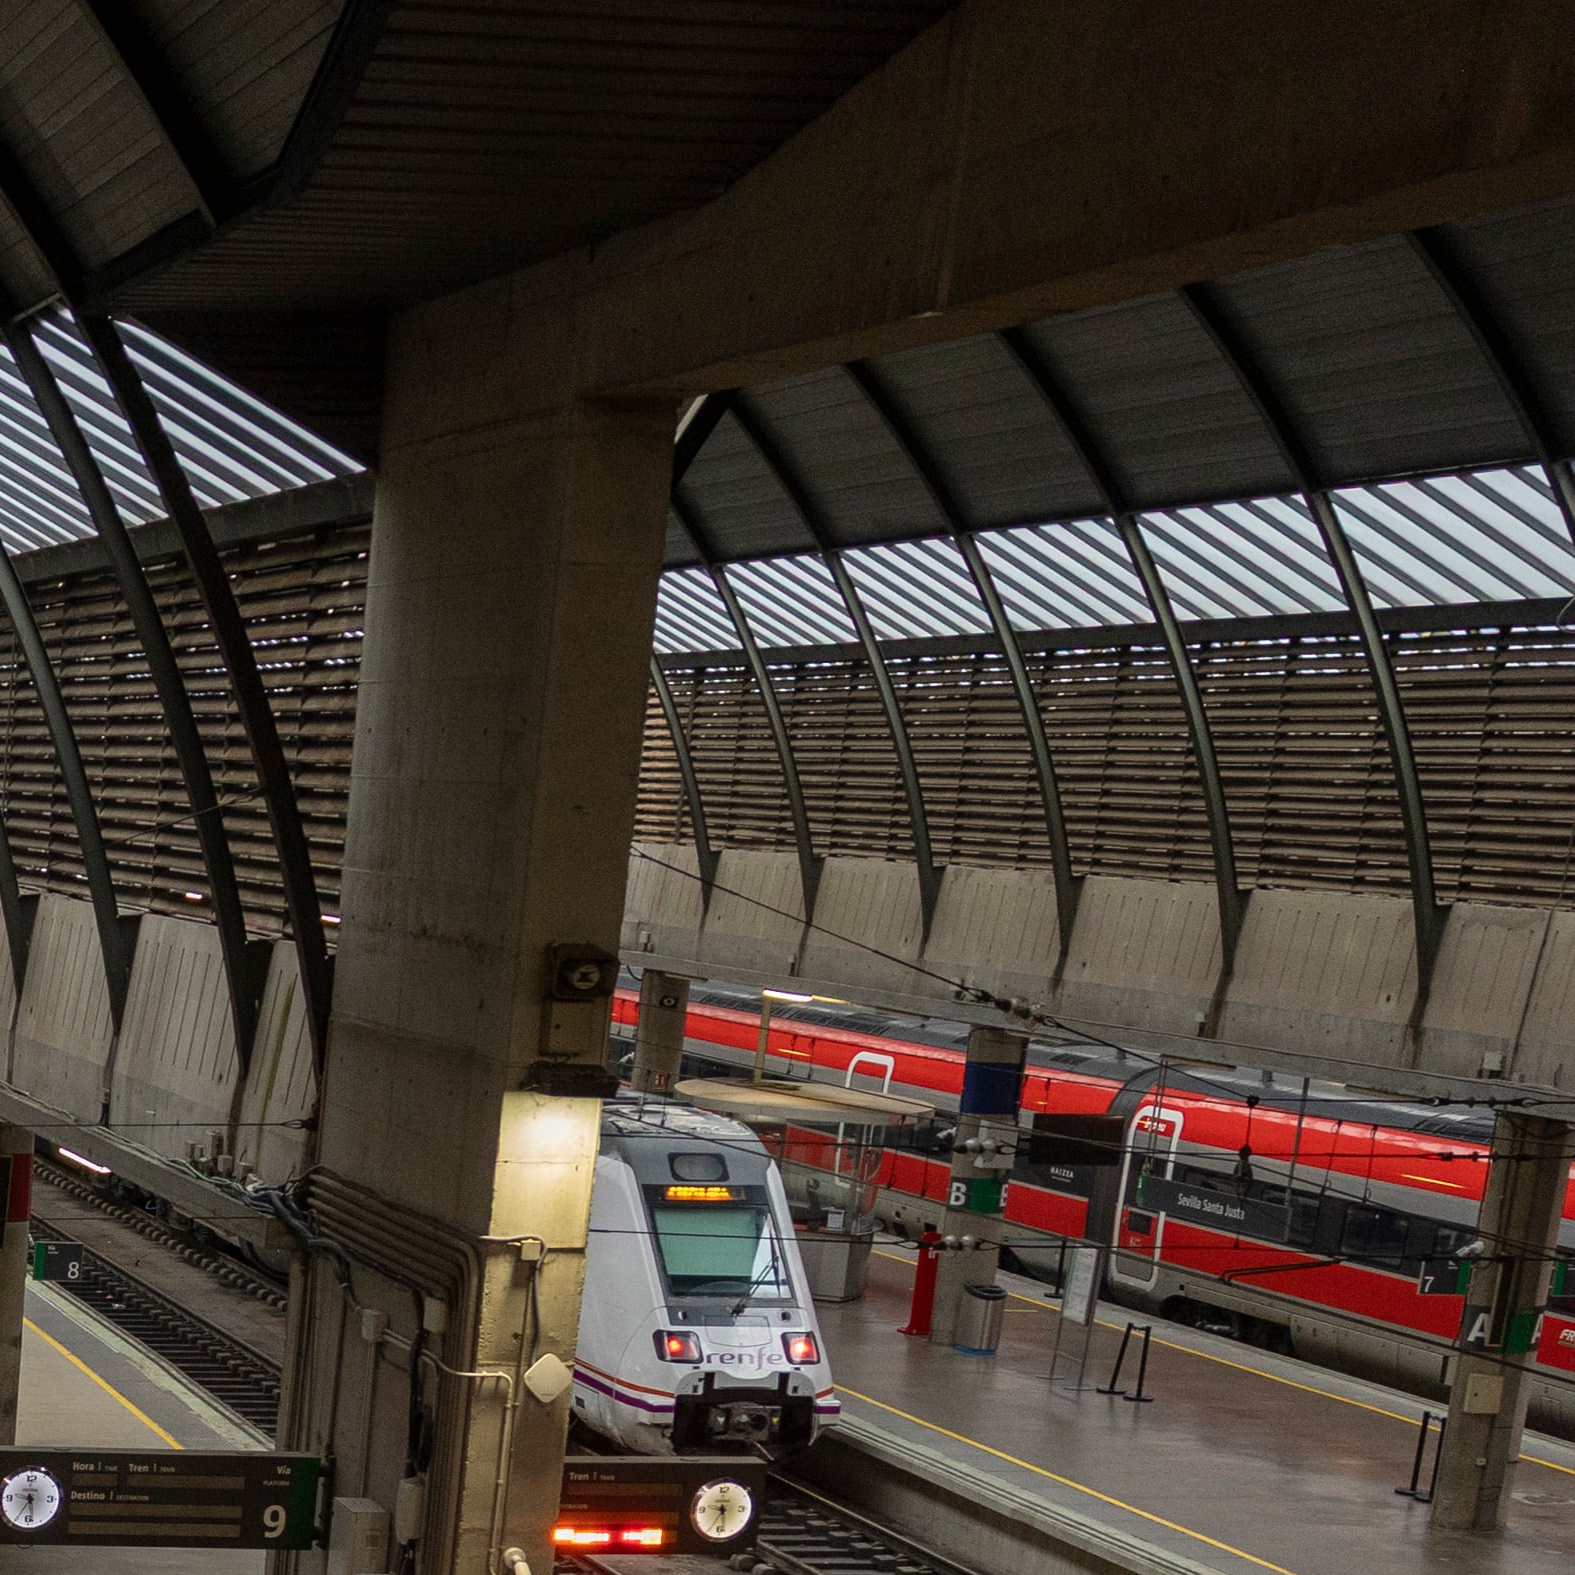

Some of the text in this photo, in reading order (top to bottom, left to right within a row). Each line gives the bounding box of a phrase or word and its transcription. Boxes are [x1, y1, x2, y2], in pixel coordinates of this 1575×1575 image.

[949, 1182, 967, 1207] B
[1178, 1193, 1245, 1220] Sevilla Santa Justa
[67, 1261, 79, 1279] 8
[1424, 1276, 1435, 1293] 7
[1467, 1312, 1491, 1342] A
[706, 1347, 783, 1370] renfe
[72, 1461, 95, 1472] Hora
[128, 1463, 149, 1472] Tren
[276, 1464, 292, 1475] Vía
[569, 1472, 589, 1481] Tren
[70, 1490, 106, 1500] Destino
[719, 1486, 730, 1494] 12
[6, 1494, 13, 1502] 9
[46, 1495, 54, 1503] 3
[698, 1506, 706, 1514] 9
[737, 1505, 746, 1513] 3
[263, 1504, 286, 1539] 9
